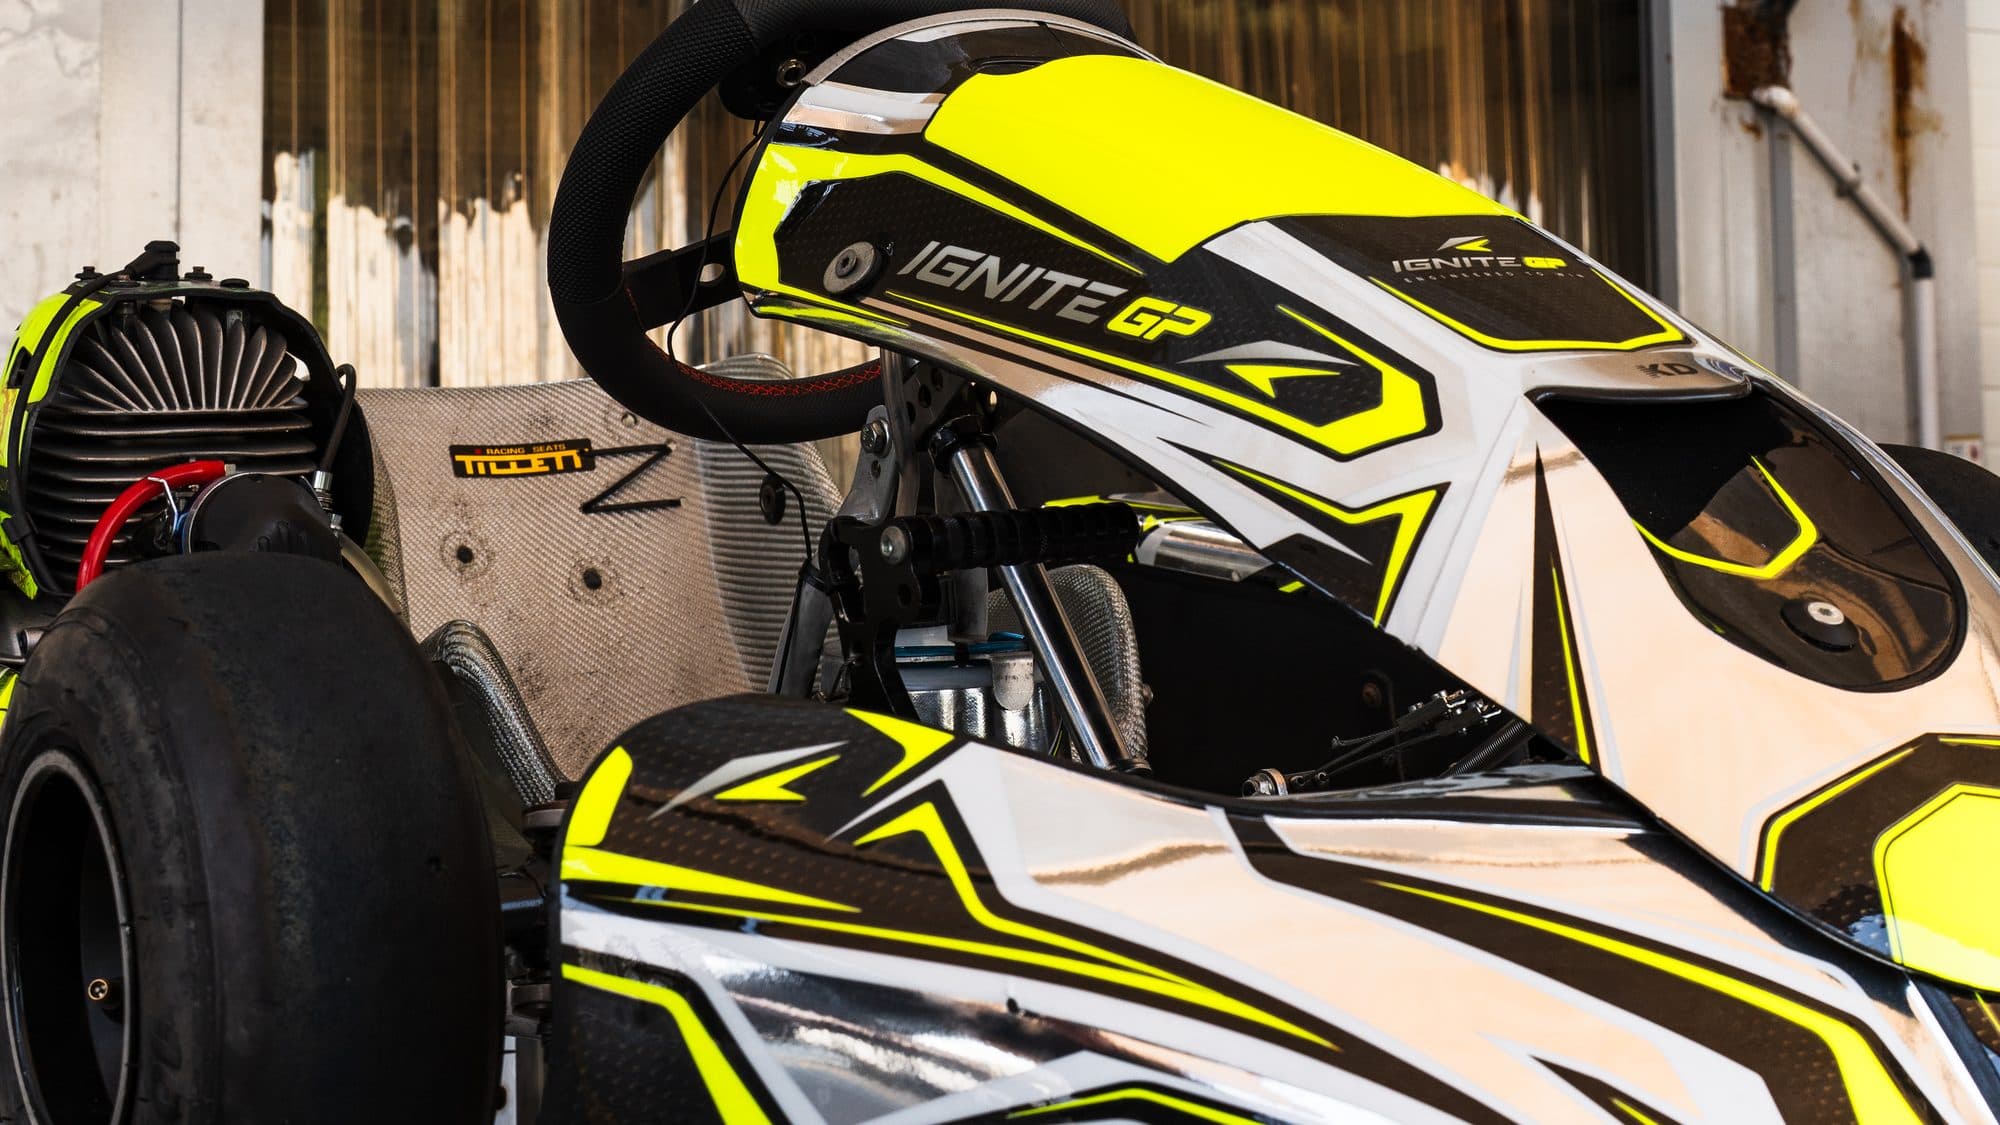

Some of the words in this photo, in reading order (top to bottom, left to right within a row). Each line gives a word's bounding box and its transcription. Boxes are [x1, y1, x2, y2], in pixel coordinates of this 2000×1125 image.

[1391, 256, 1522, 273] IGNITE
[896, 240, 1129, 324] IGNITE
[1106, 296, 1213, 341] GP
[486, 446, 525, 455] RACING
[533, 443, 566, 453] SEATS
[455, 449, 583, 475] TILLETT
